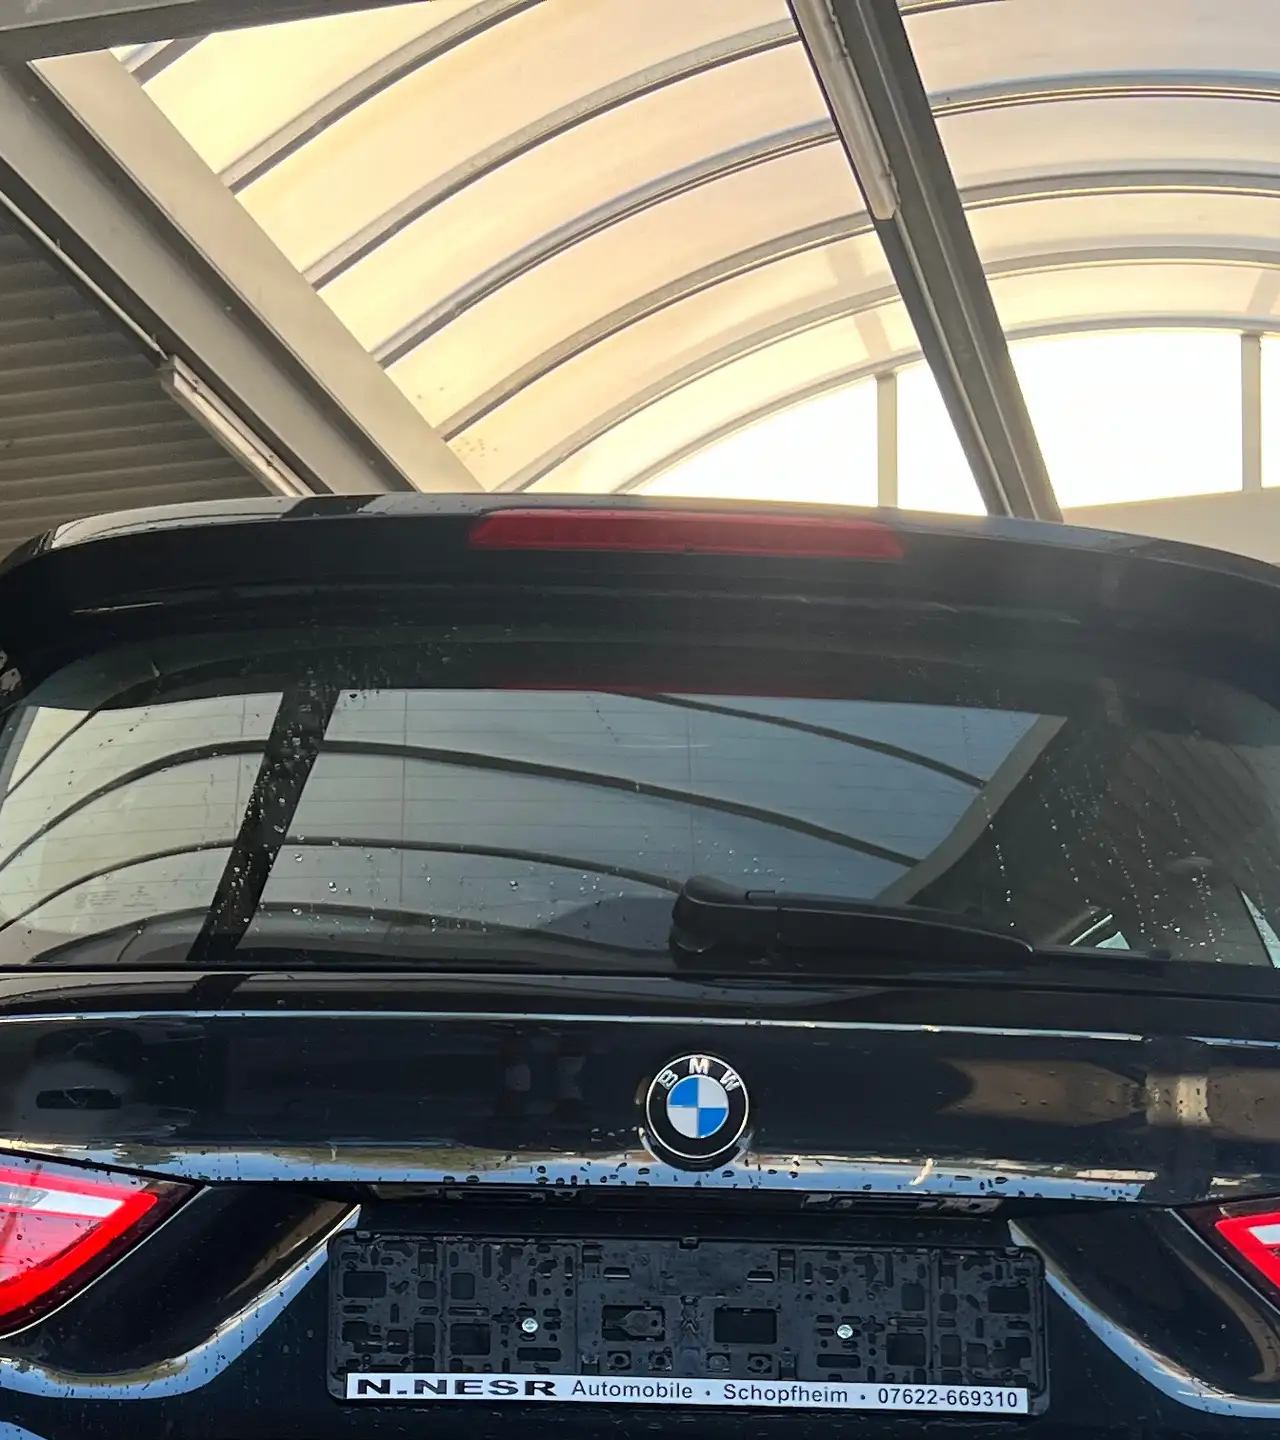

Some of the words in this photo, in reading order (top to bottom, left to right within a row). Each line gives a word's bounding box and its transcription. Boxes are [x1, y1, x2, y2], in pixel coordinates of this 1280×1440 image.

[658, 1057, 741, 1092] BMW
[572, 1379, 693, 1399] Automobile
[723, 1384, 848, 1404] Schopfheim
[878, 1387, 1018, 1408] 07622-669310
